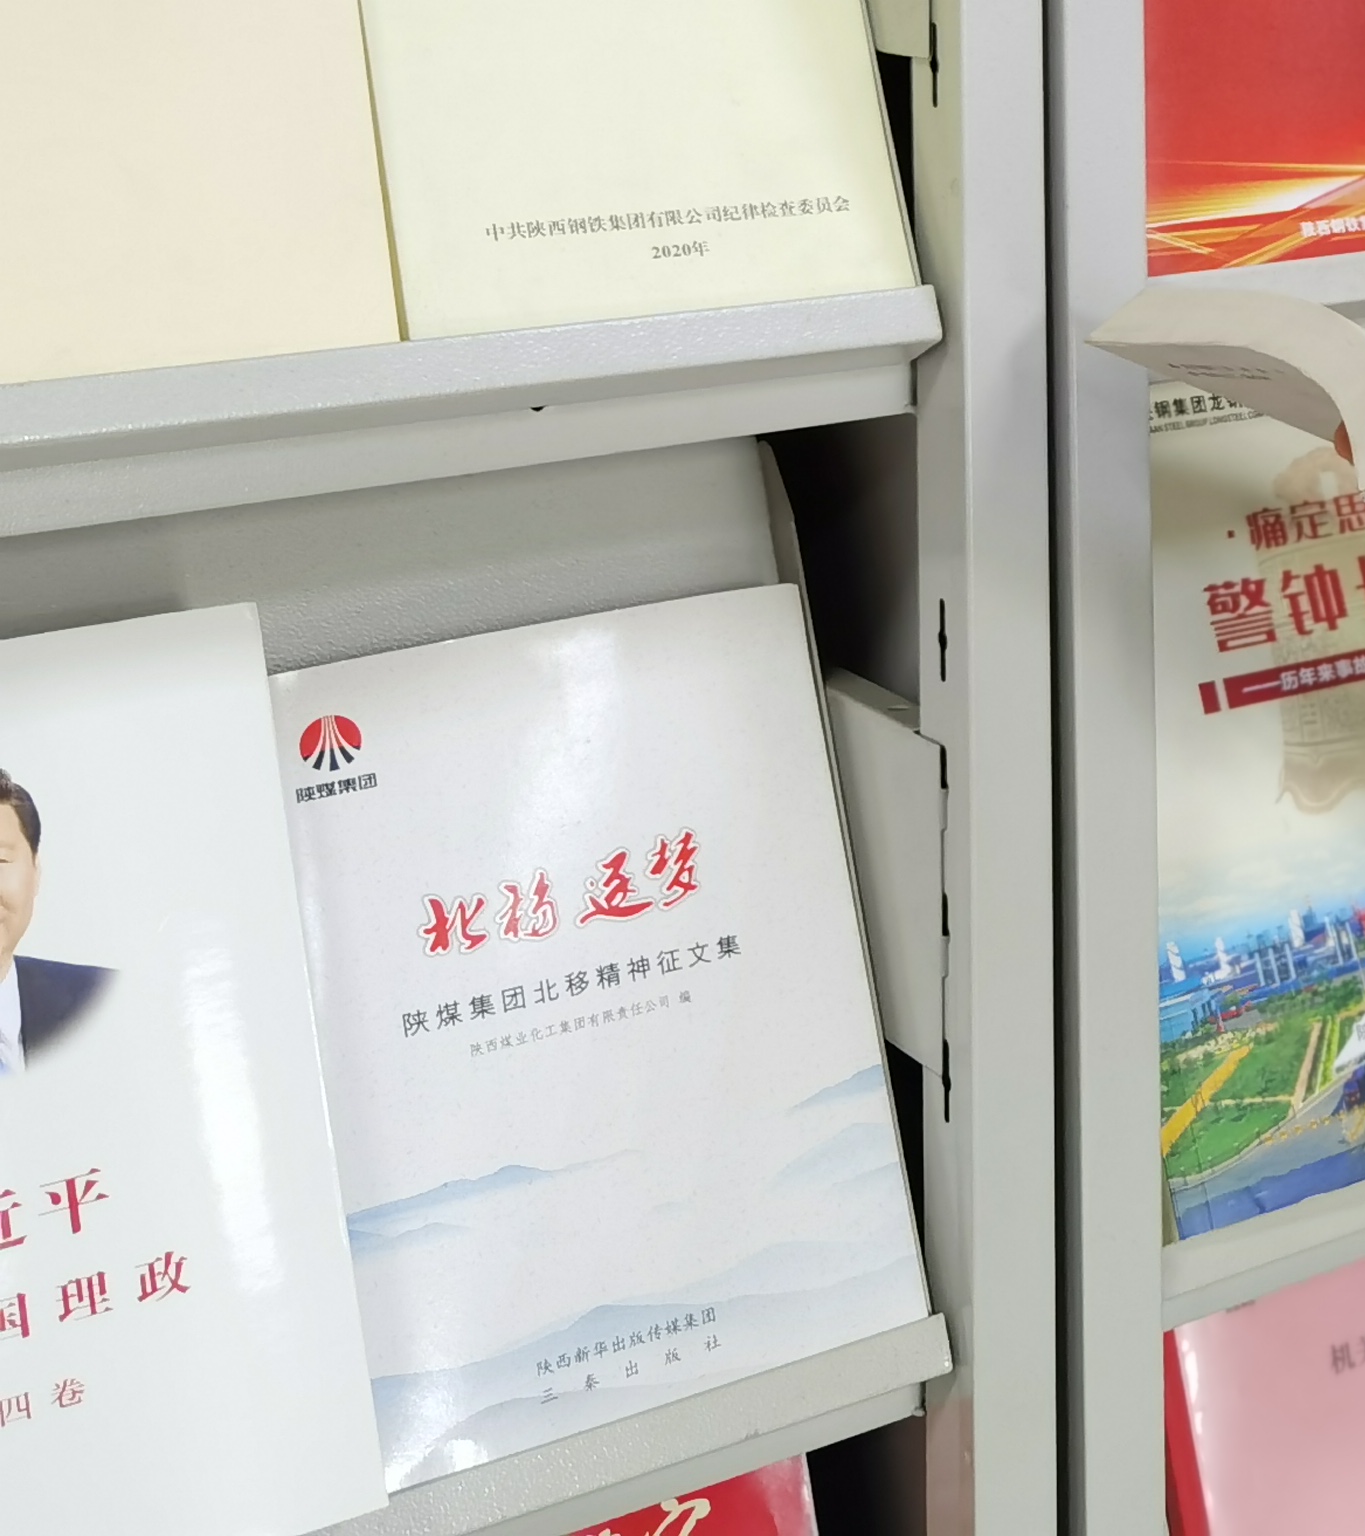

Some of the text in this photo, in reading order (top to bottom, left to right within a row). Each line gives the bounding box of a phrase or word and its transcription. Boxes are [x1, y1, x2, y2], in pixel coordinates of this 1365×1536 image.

[485, 195, 852, 243] 中共陕西钢铁集团有限公司纪律检查委员会
[650, 238, 711, 260] 2020年
[296, 771, 378, 805] 陕煤集团
[420, 828, 702, 956] 北移逐梦
[402, 934, 743, 1038] 陕煤集团北移精神征文集
[469, 996, 671, 1059] 陕西煤业化工集团有限责任公司
[536, 1306, 717, 1377] 陕西新华出版传媒集团
[540, 1334, 722, 1405] 三秦出版社
